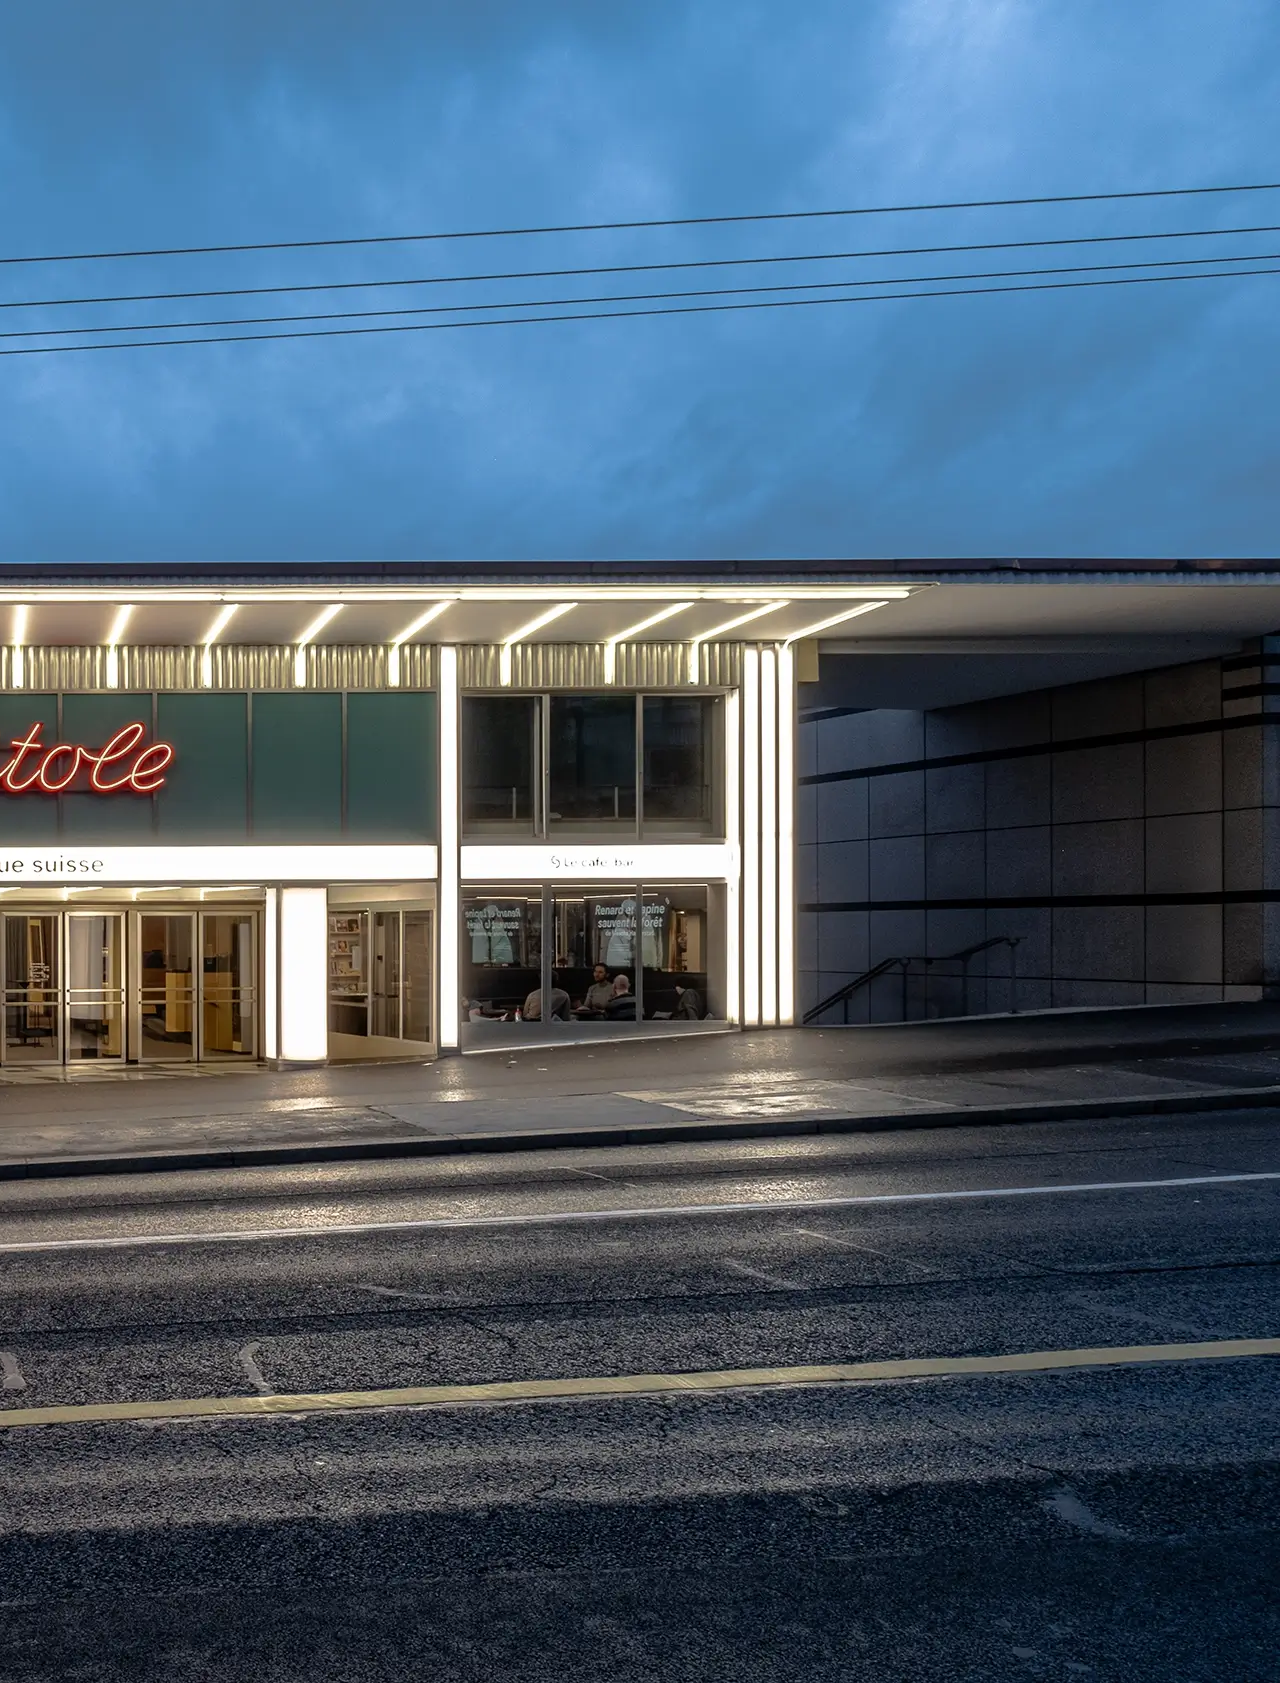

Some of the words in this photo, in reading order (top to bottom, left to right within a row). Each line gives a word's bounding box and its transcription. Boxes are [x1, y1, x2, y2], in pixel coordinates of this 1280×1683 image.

[32, 855, 104, 873] suisse
[595, 904, 624, 916] Renard
[641, 903, 665, 917] apine
[597, 917, 630, 929] sauvent
